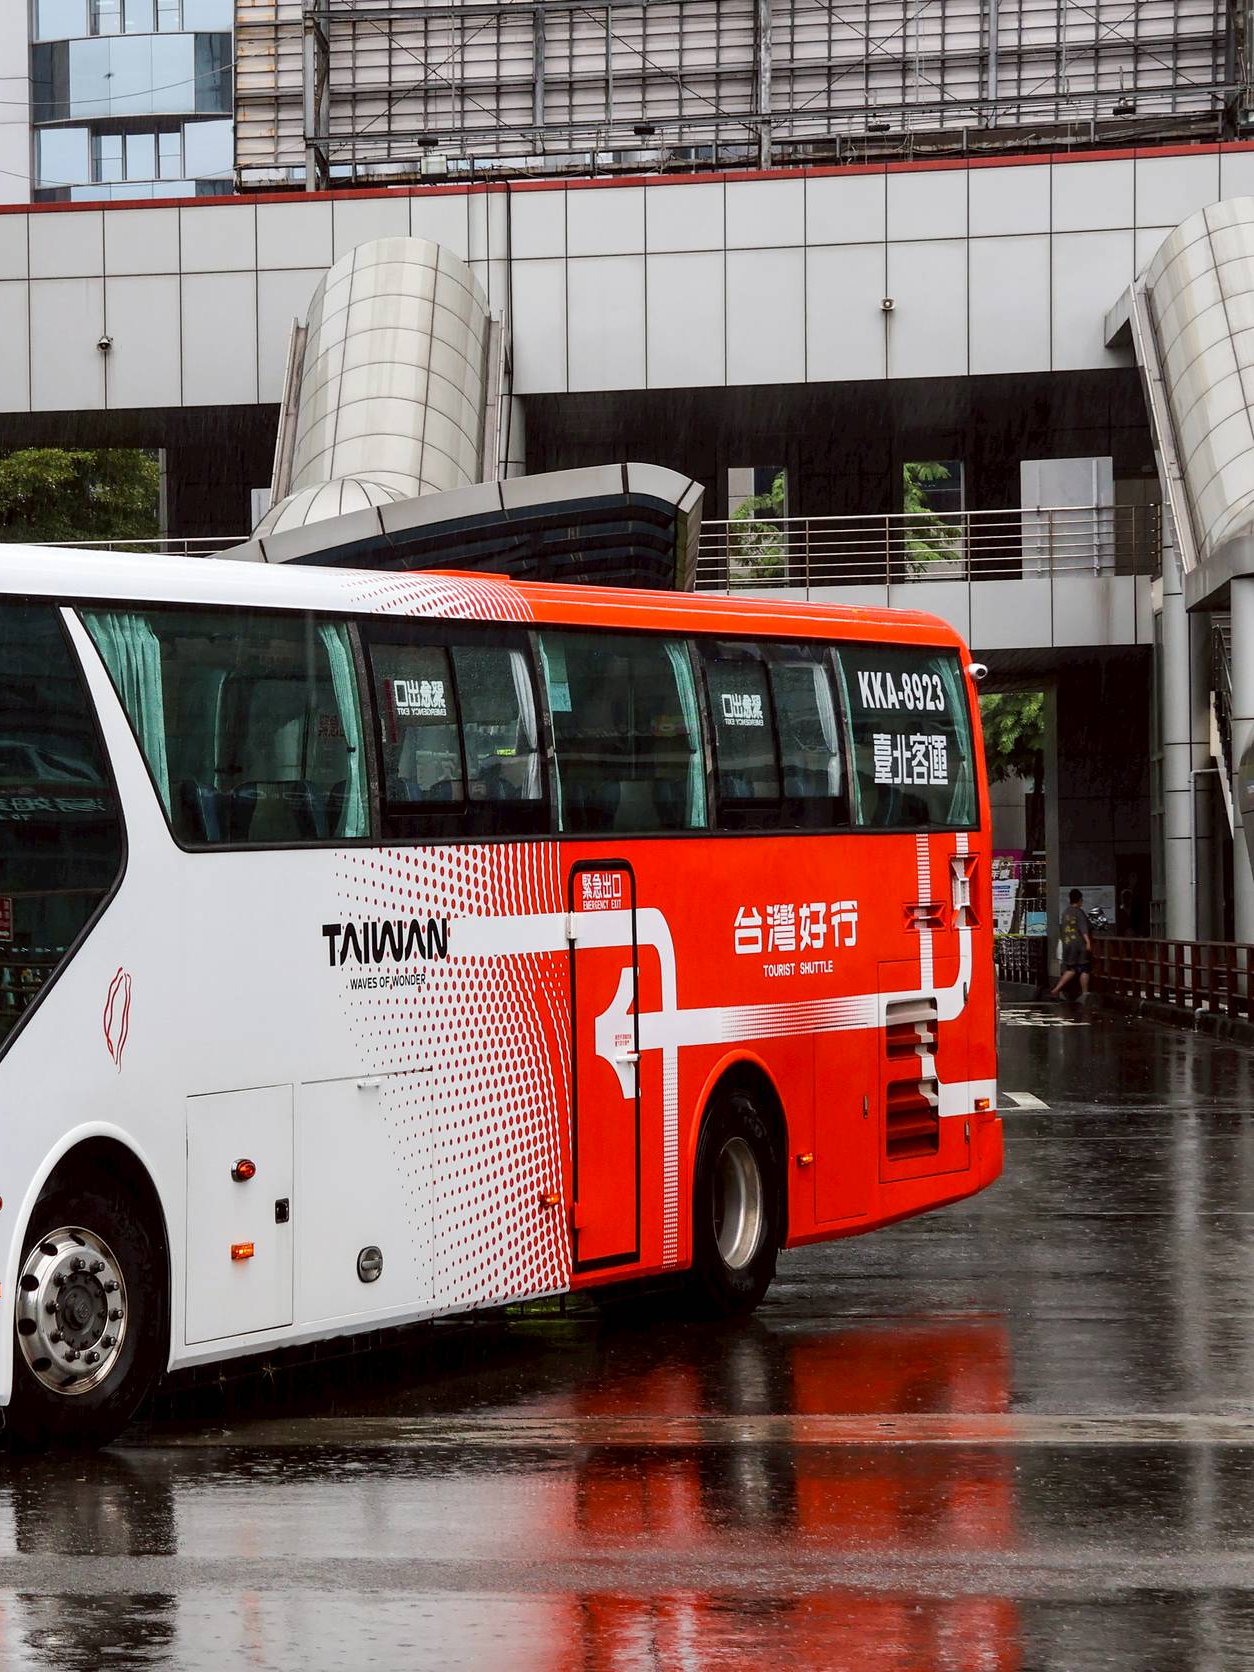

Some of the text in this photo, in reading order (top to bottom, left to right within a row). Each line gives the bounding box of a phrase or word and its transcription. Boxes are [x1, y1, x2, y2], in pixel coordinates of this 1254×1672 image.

[857, 671, 945, 711] KKA-8923
[873, 733, 948, 785] 臺北客運
[582, 872, 621, 900] 緊急出口
[322, 918, 447, 966] TAIWAN
[734, 900, 859, 955] 台灣好行
[350, 974, 426, 990] WAVES OF WONDER
[763, 960, 833, 977] TOURIST SHUTTLE
